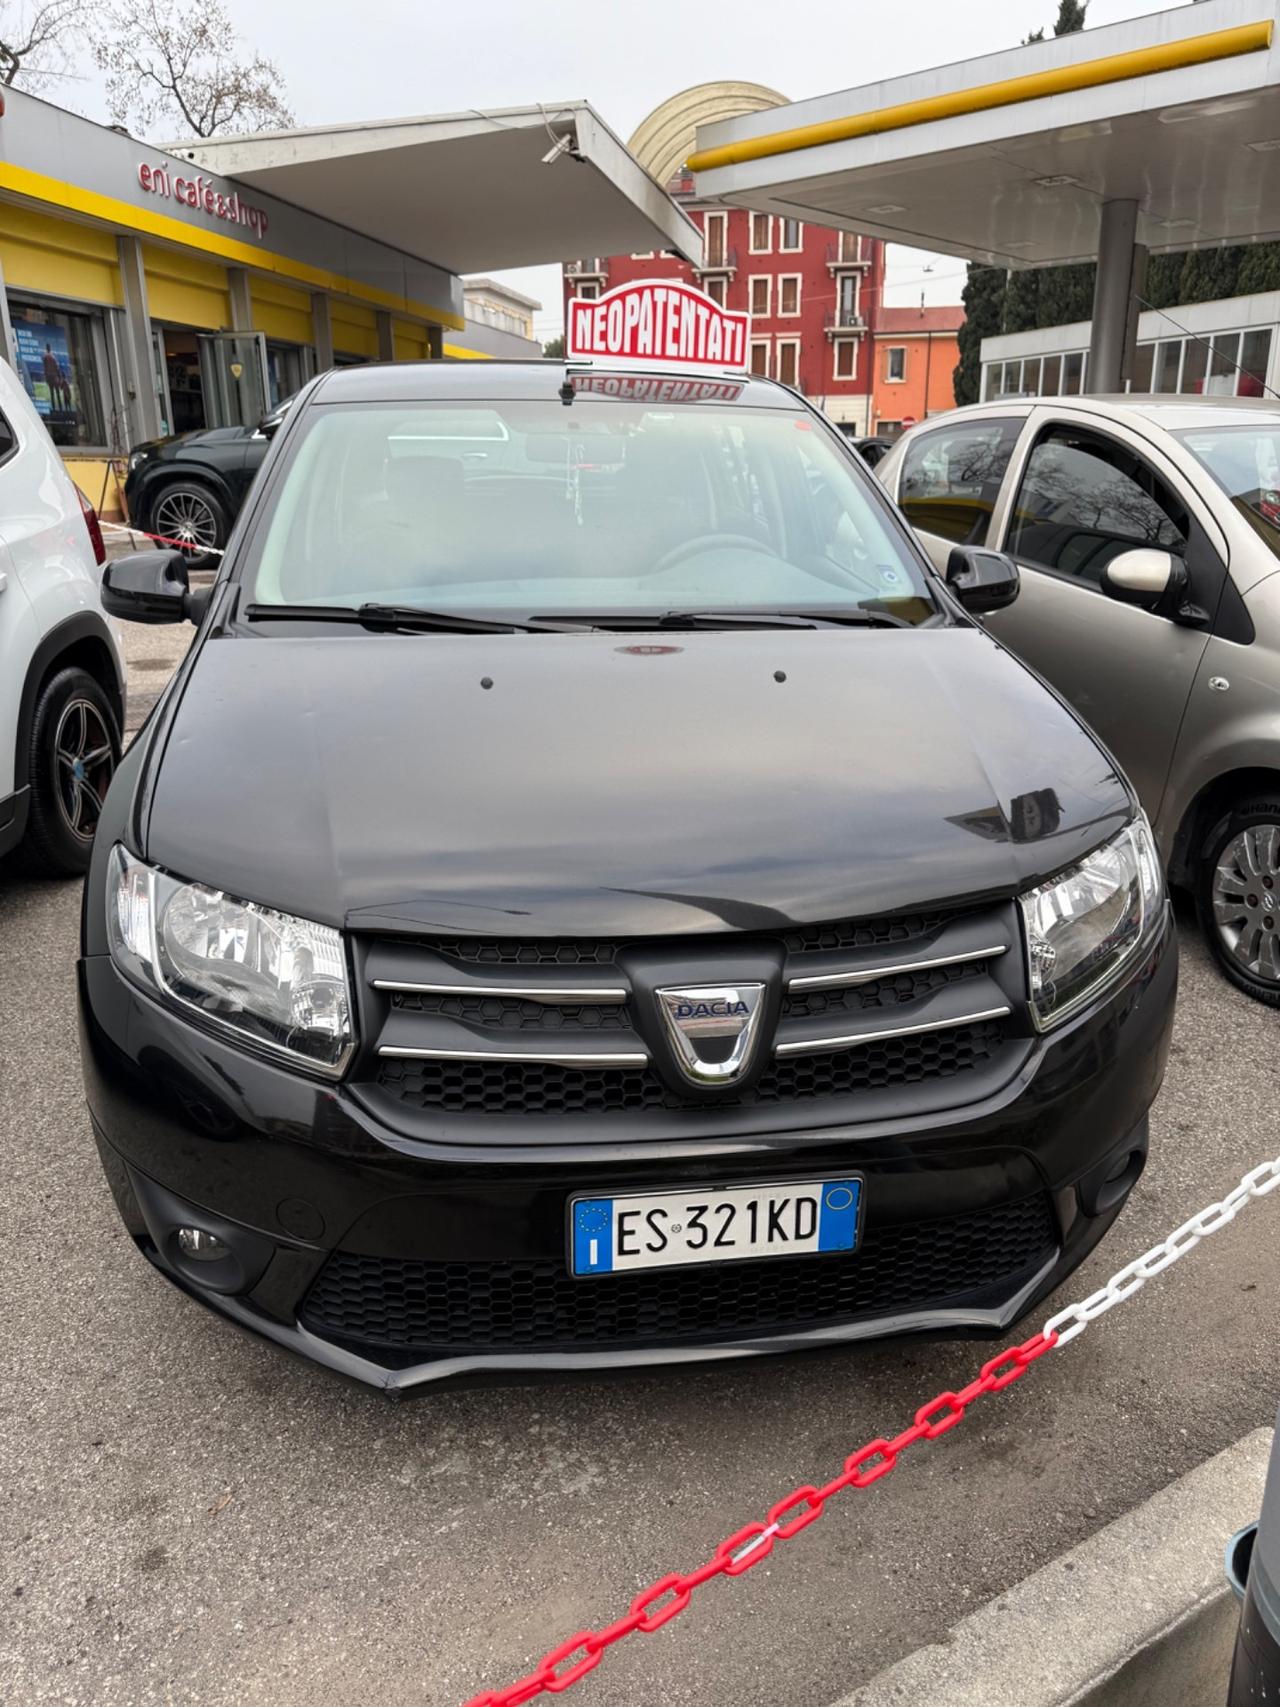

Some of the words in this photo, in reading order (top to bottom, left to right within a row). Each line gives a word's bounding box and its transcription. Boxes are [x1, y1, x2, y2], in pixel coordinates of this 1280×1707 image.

[138, 161, 171, 199] eni
[575, 288, 743, 362] NEOPATENTATI
[676, 1000, 750, 1019] DACIA
[617, 1208, 668, 1256] ES
[685, 1197, 819, 1250] 321KD
